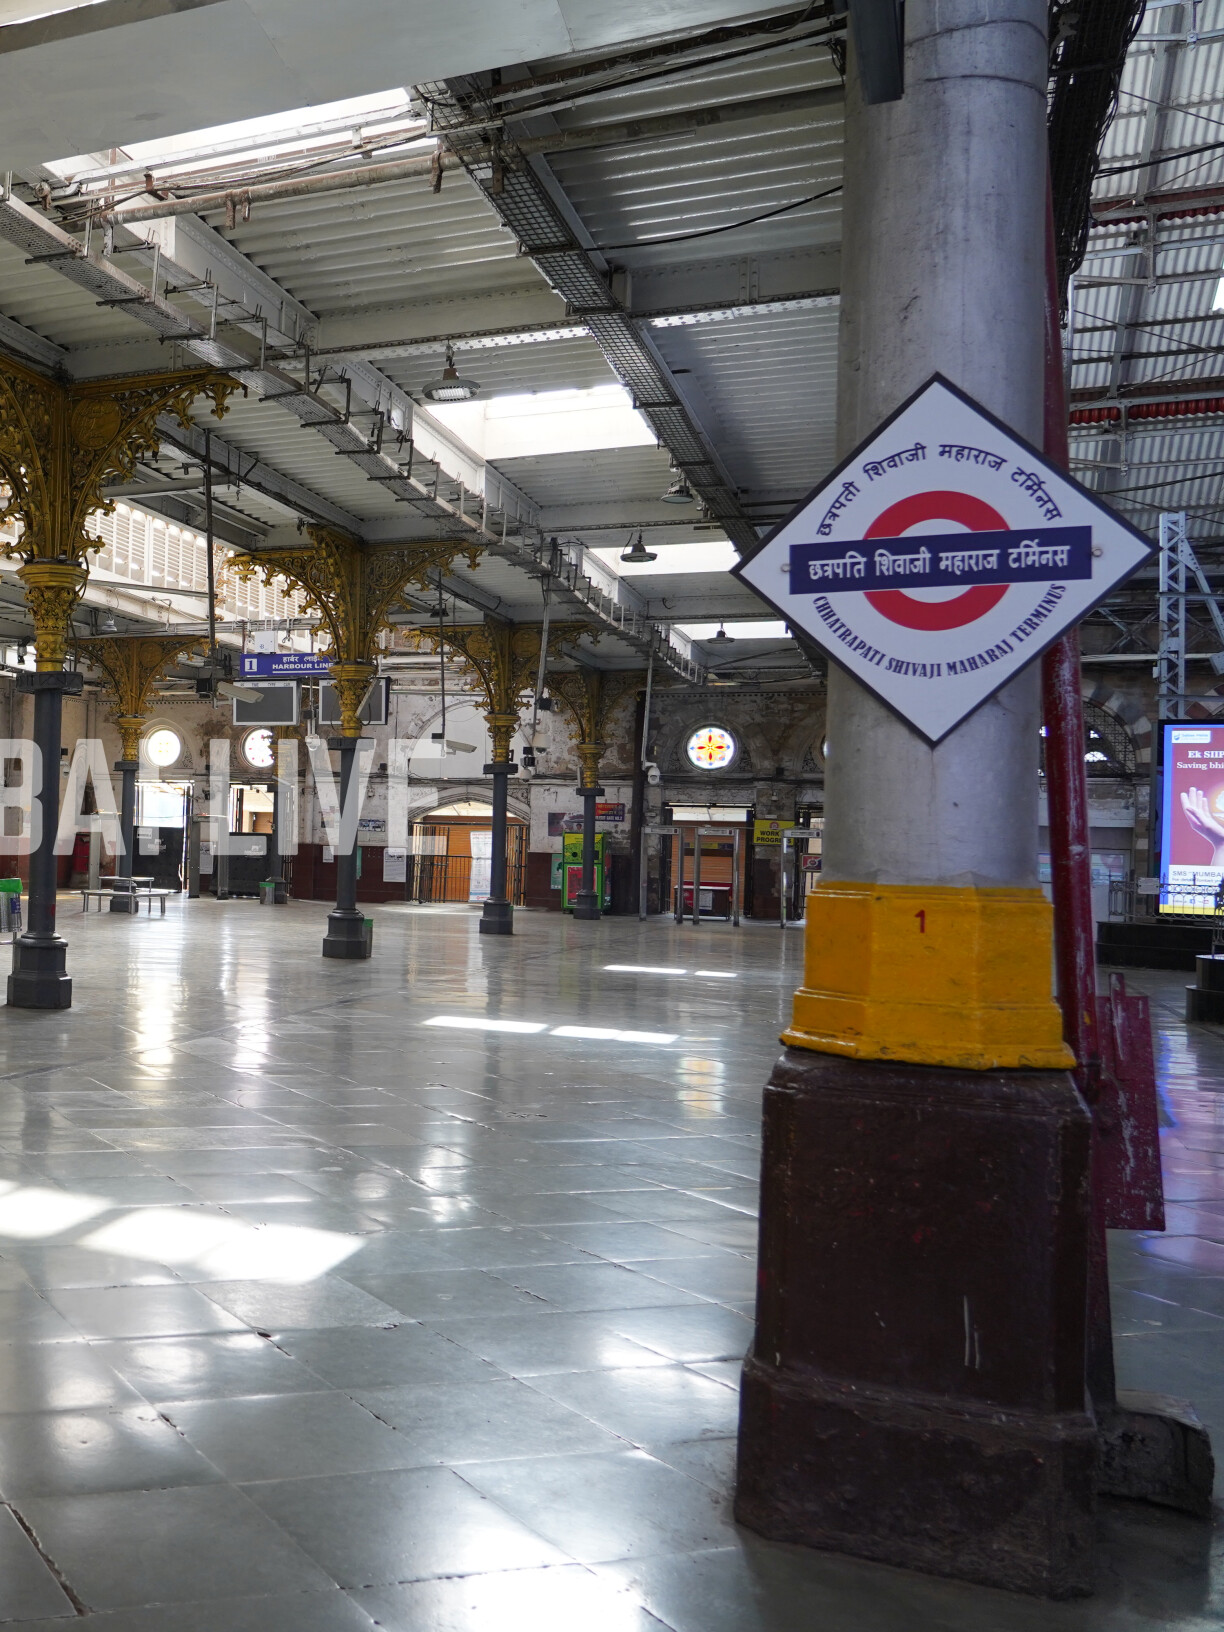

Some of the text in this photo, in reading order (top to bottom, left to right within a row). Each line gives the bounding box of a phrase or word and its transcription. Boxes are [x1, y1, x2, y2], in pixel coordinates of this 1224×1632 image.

[816, 442, 1063, 536] छत्रपती शिवाजी महाराज टर्मिनस
[808, 539, 1071, 580] छत्रपति शिवाजी महाराज टर्मिनस
[812, 583, 1066, 679] CHHATRAPATI SHIVAJI MAHARAJ TERMINUS
[246, 659, 256, 671] 1
[1176, 762, 1208, 770] Saving
[1188, 750, 1202, 758] Ek
[914, 909, 925, 934] 1
